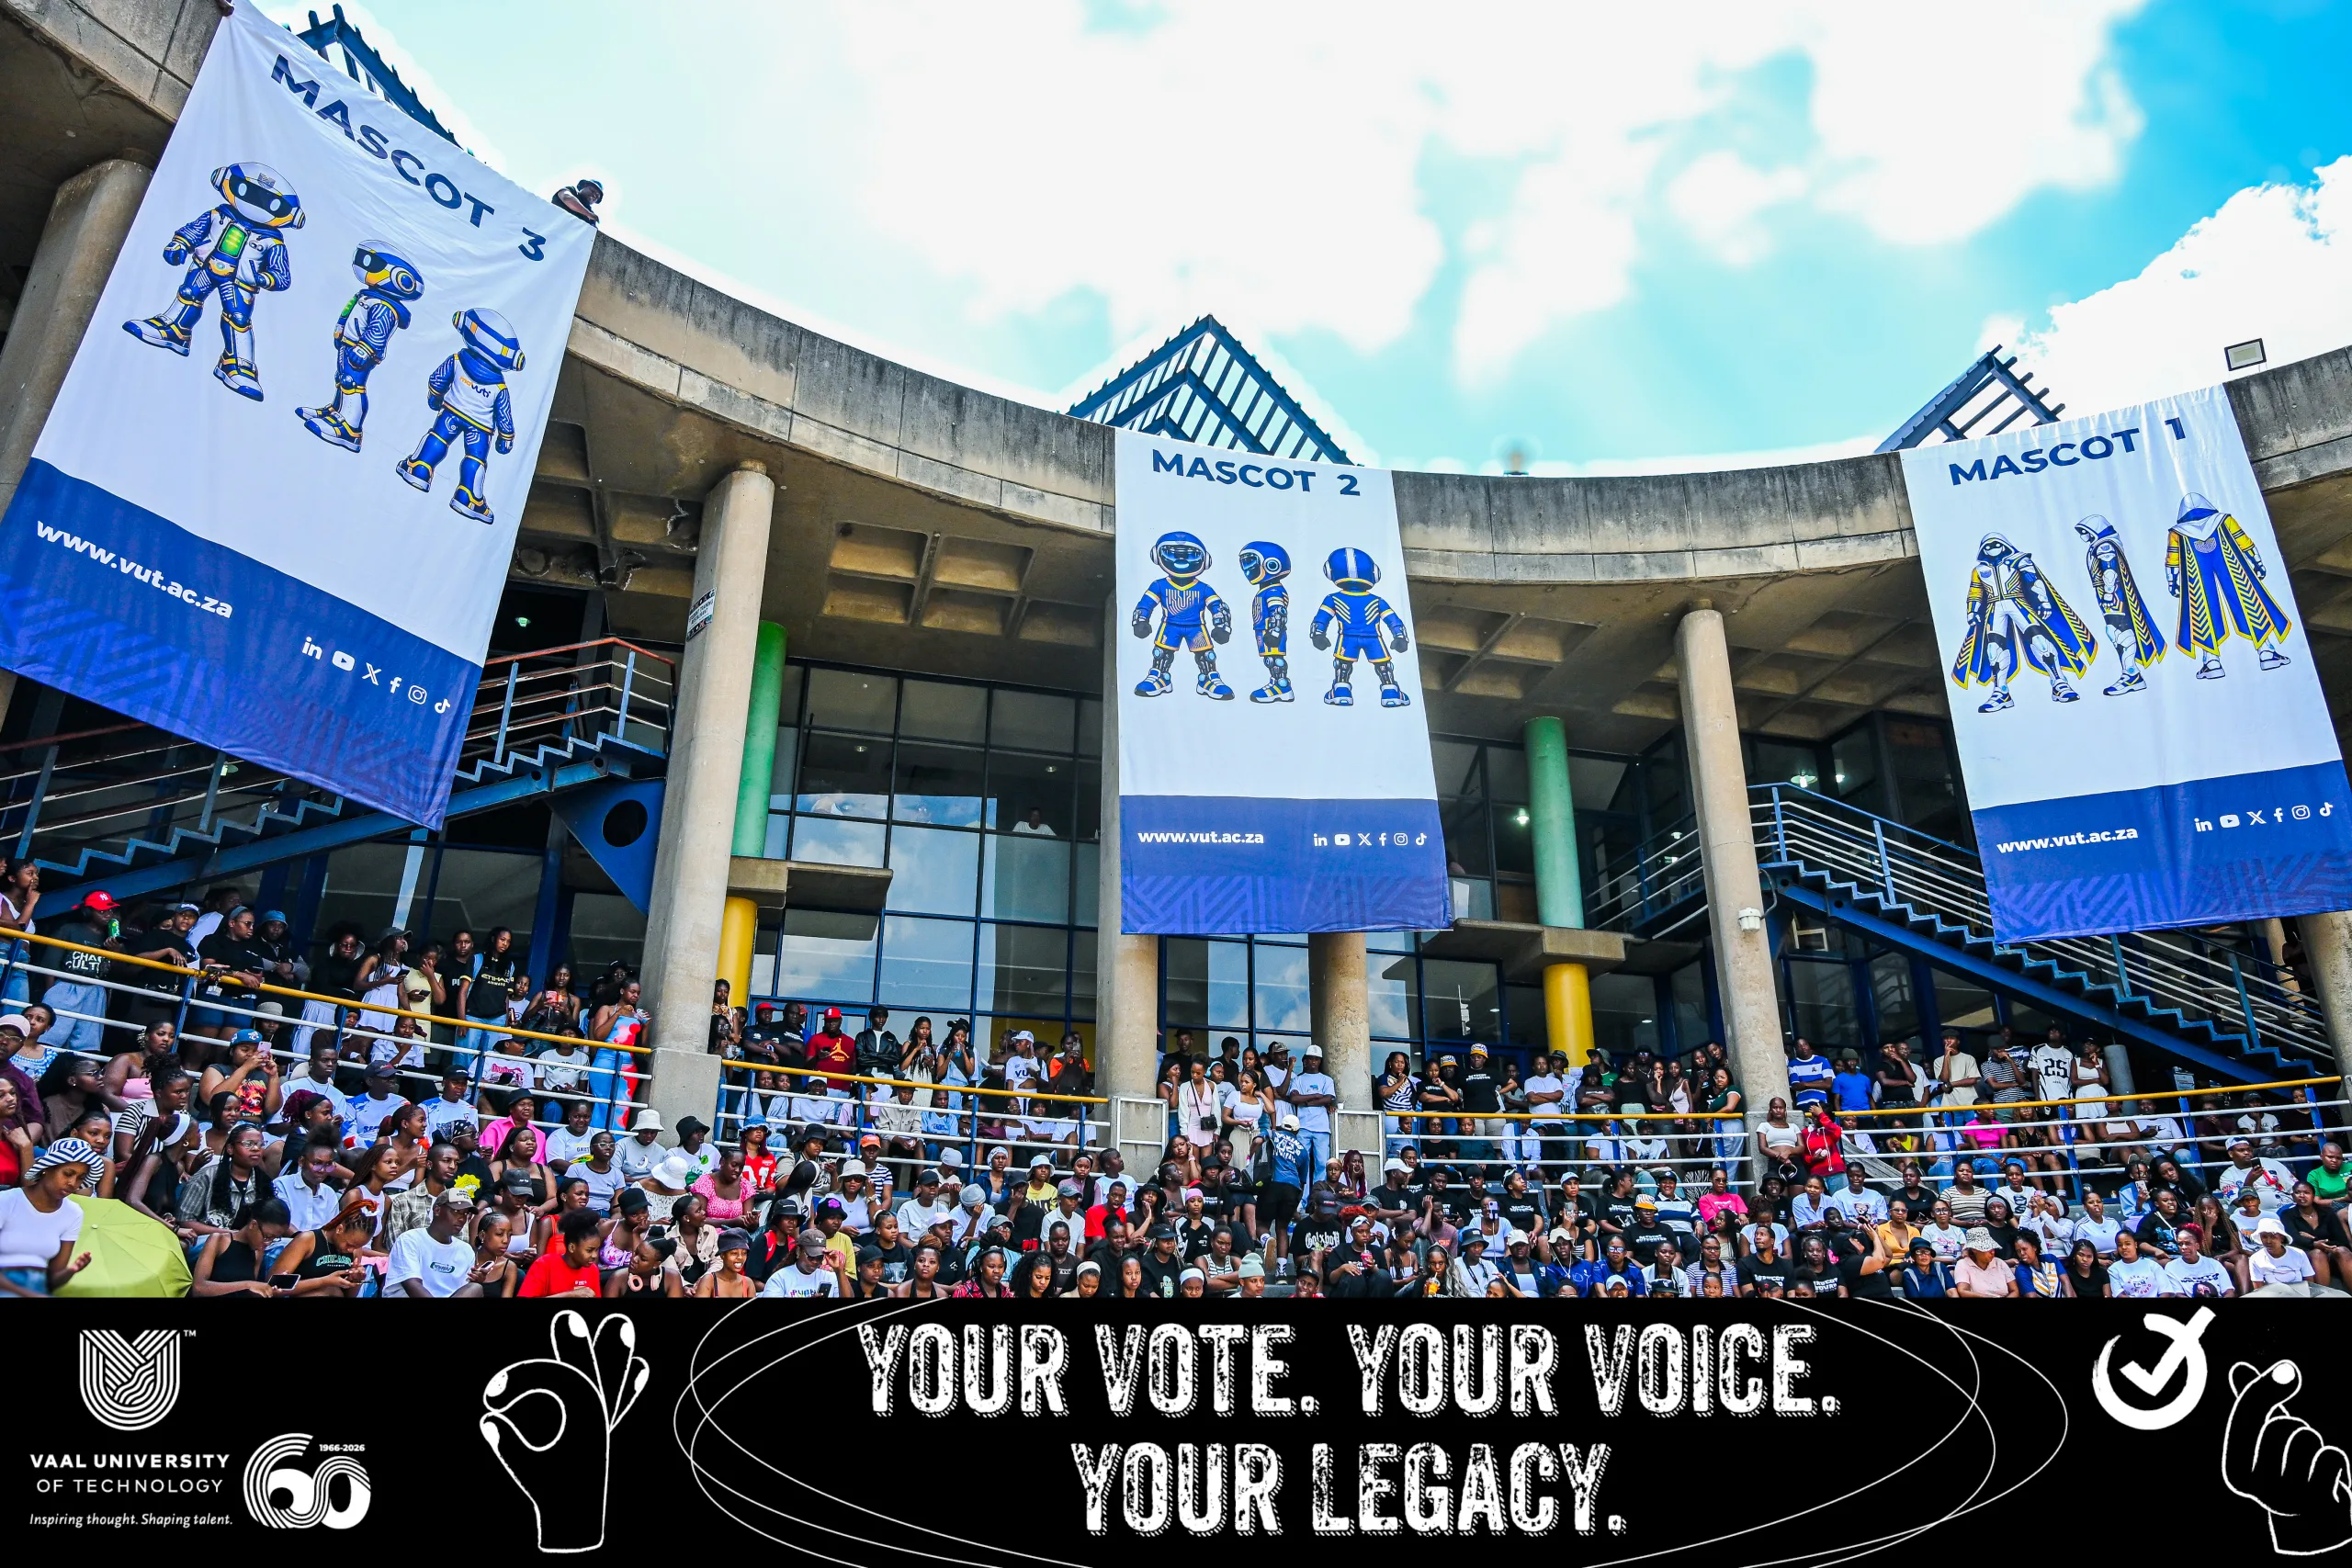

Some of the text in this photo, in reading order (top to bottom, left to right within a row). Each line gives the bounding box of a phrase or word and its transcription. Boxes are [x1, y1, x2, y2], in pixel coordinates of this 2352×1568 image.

[271, 53, 547, 261] MASCOT 3
[1152, 448, 1361, 496] MASCOT 2
[1949, 416, 2186, 486] MASCOT 1
[37, 520, 233, 618] www.vut.ac.za
[1137, 830, 1265, 844] www.vut.ac.za
[1996, 828, 2139, 853] www.vut.ac.za
[2043, 1057, 2069, 1079] 25
